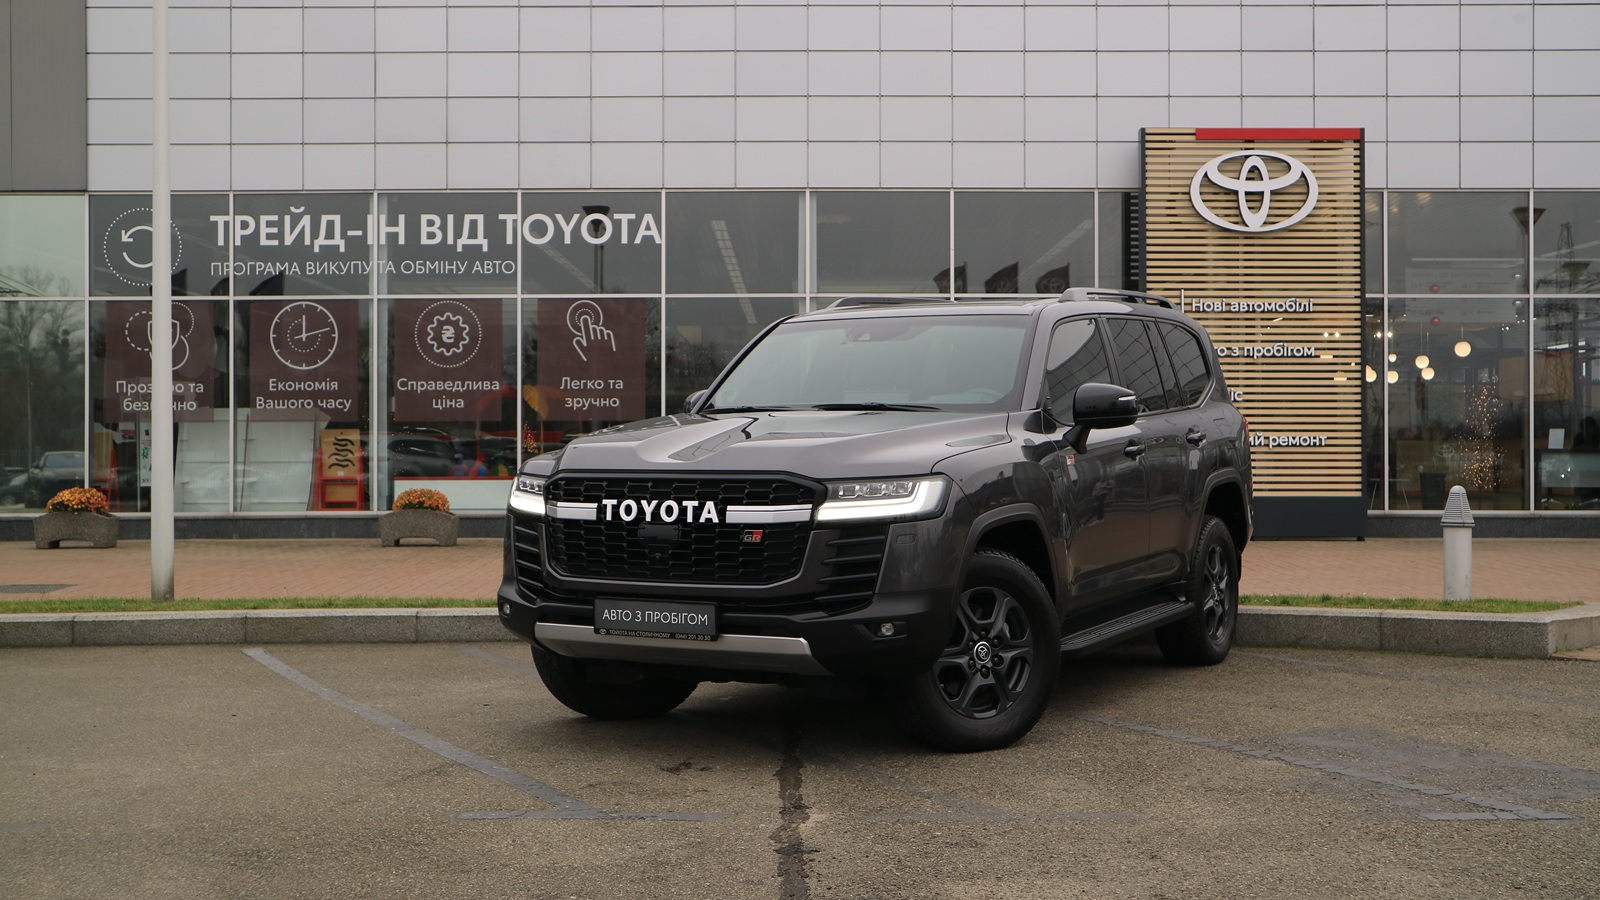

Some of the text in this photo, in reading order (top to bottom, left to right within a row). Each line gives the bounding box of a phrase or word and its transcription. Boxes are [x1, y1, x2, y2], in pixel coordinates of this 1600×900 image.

[209, 206, 662, 252] ТРЕЙД-ІН ВІД TOYOTA
[210, 260, 516, 276] ПРОГРАМА ВИКУПУ ТА ОБМІНУ АВТО
[1192, 298, 1313, 312] Нові автомобілі
[1231, 346, 1239, 357] з
[1244, 343, 1315, 359] пробігом
[188, 383, 204, 393] та
[269, 378, 338, 391] Економія
[396, 378, 500, 394] Справедлива
[560, 377, 624, 390] Легко та
[256, 396, 352, 412] Вашого часу
[432, 395, 464, 410] ціна
[564, 397, 620, 411] зручно
[1269, 436, 1327, 450] ремонт
[602, 499, 719, 524] TOYOTA
[602, 609, 632, 622] АВТО
[645, 611, 708, 625] ПРОБІГОМ
